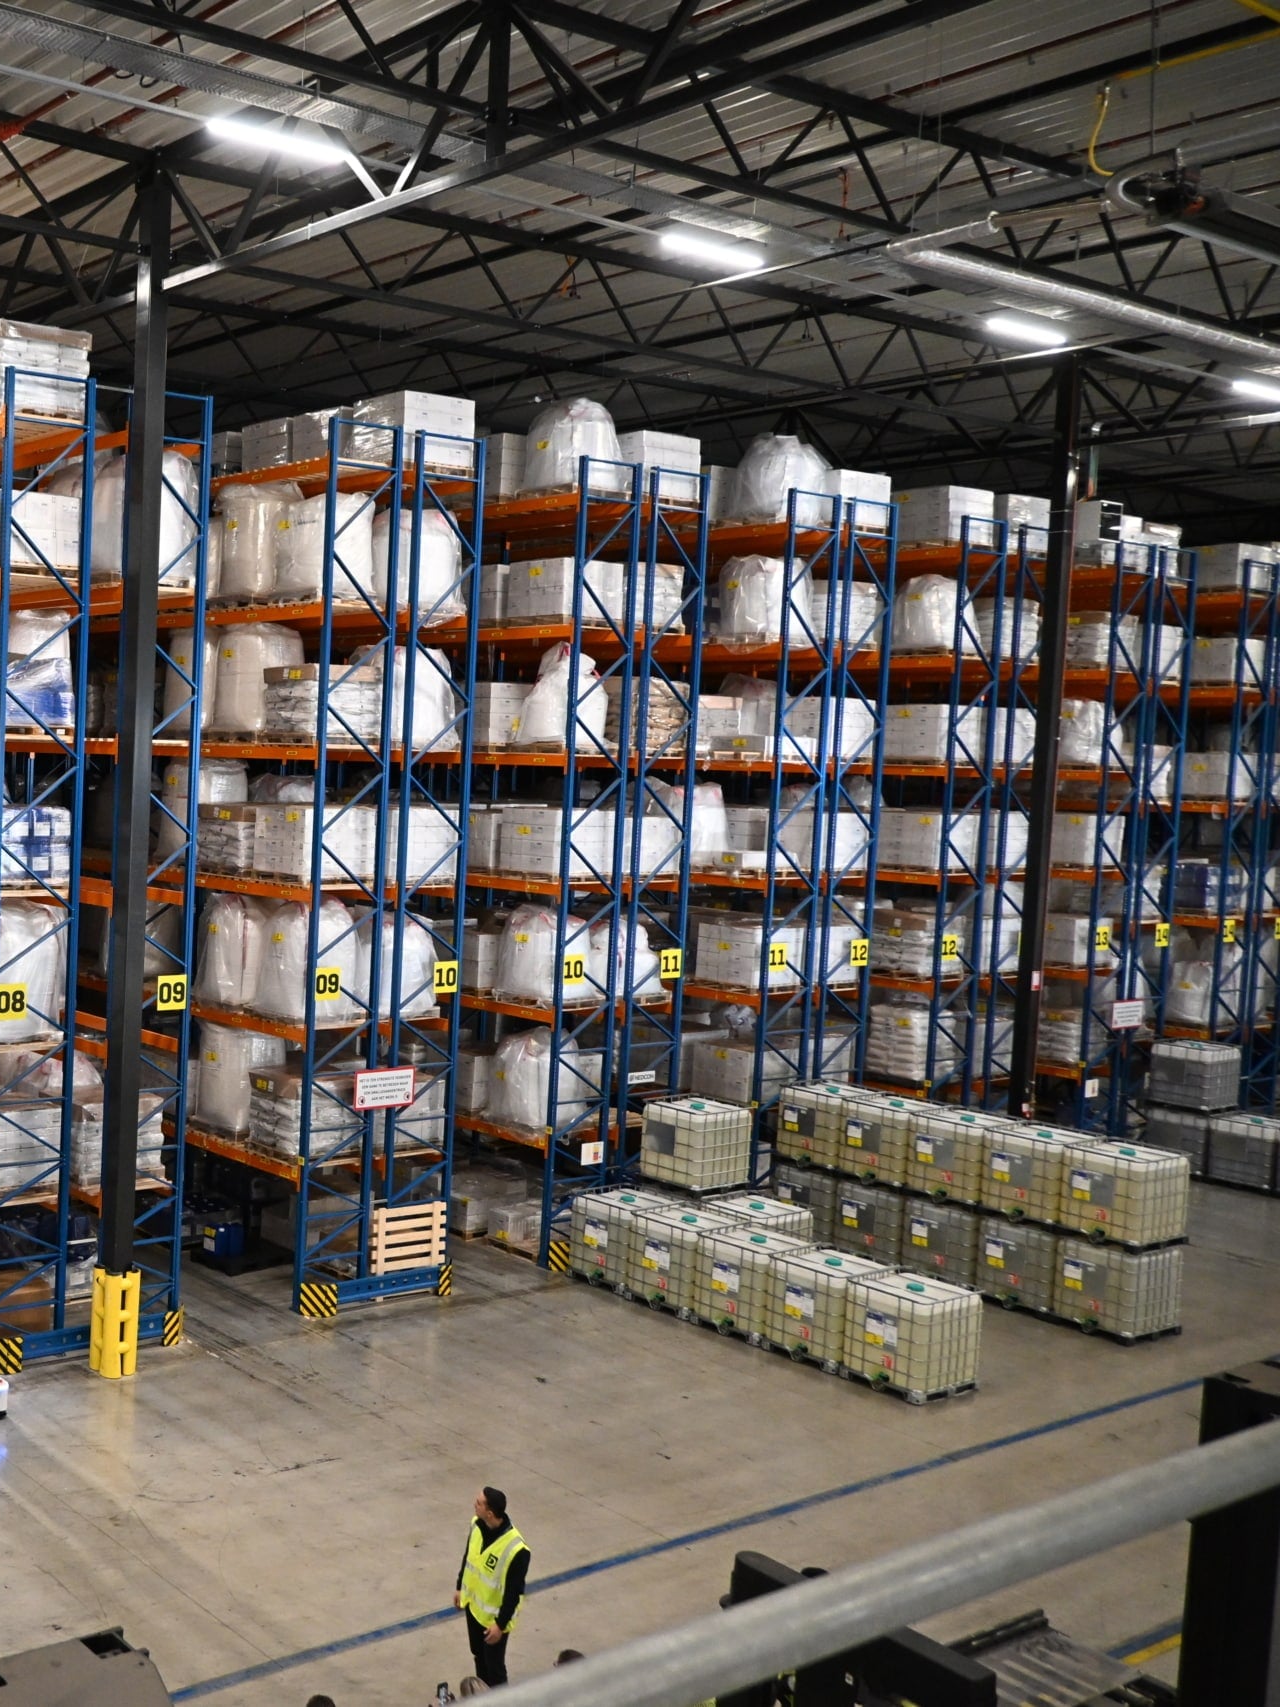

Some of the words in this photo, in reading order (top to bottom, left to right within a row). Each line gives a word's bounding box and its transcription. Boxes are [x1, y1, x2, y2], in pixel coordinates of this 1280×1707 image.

[1096, 931, 1108, 946] 13
[1158, 928, 1169, 943] 14
[1224, 925, 1235, 938] 14
[852, 945, 867, 962] 12
[942, 940, 956, 957] 12
[662, 956, 679, 974] 11
[770, 950, 784, 967] 11
[436, 967, 456, 987] 10
[564, 960, 583, 979] 10
[159, 982, 186, 1004] 09
[316, 974, 339, 995] 09
